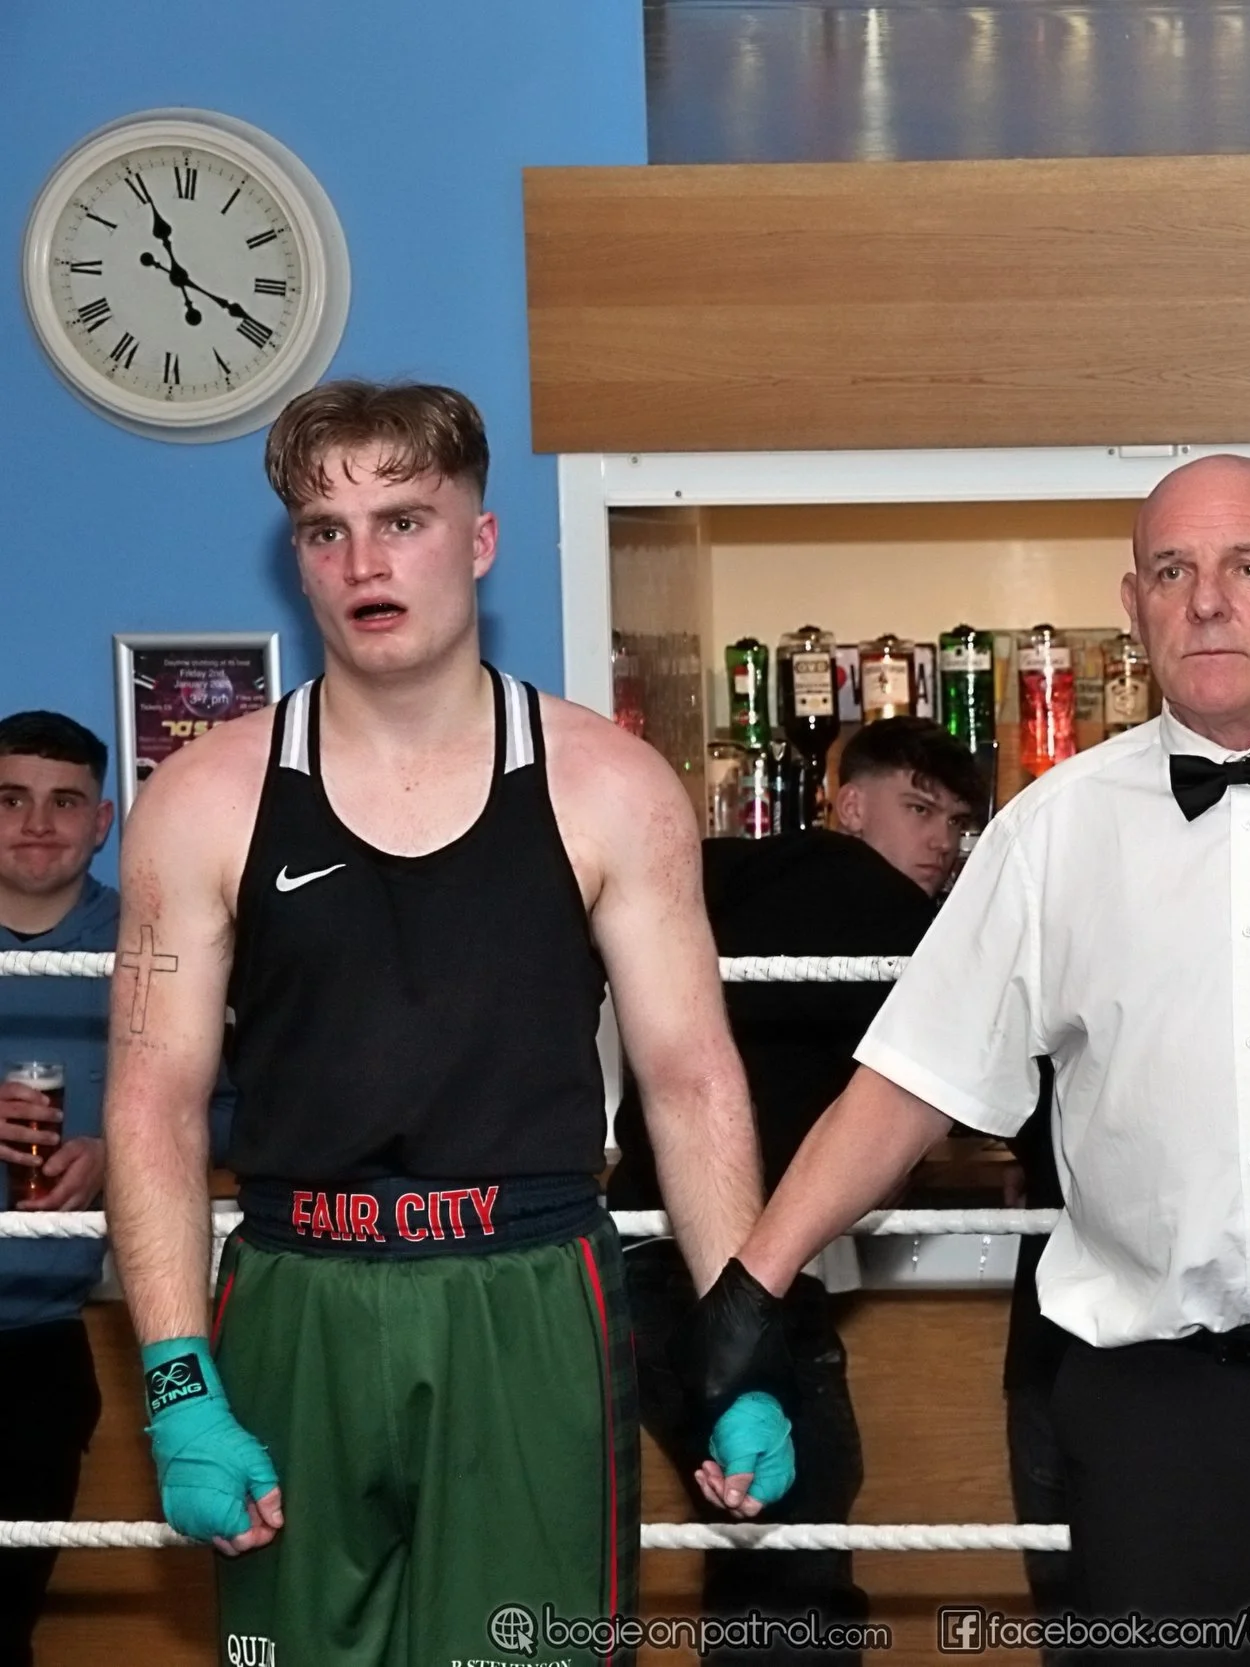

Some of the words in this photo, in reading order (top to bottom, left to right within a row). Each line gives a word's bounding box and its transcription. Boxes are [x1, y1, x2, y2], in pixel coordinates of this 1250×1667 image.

[180, 668, 206, 678] Friday
[208, 668, 225, 677] 2nd
[174, 680, 208, 690] January
[189, 693, 208, 704] 3-7
[211, 694, 229, 705] pm
[292, 1190, 386, 1243] FAIR
[395, 1185, 499, 1242] CITY
[151, 1382, 202, 1410] STING
